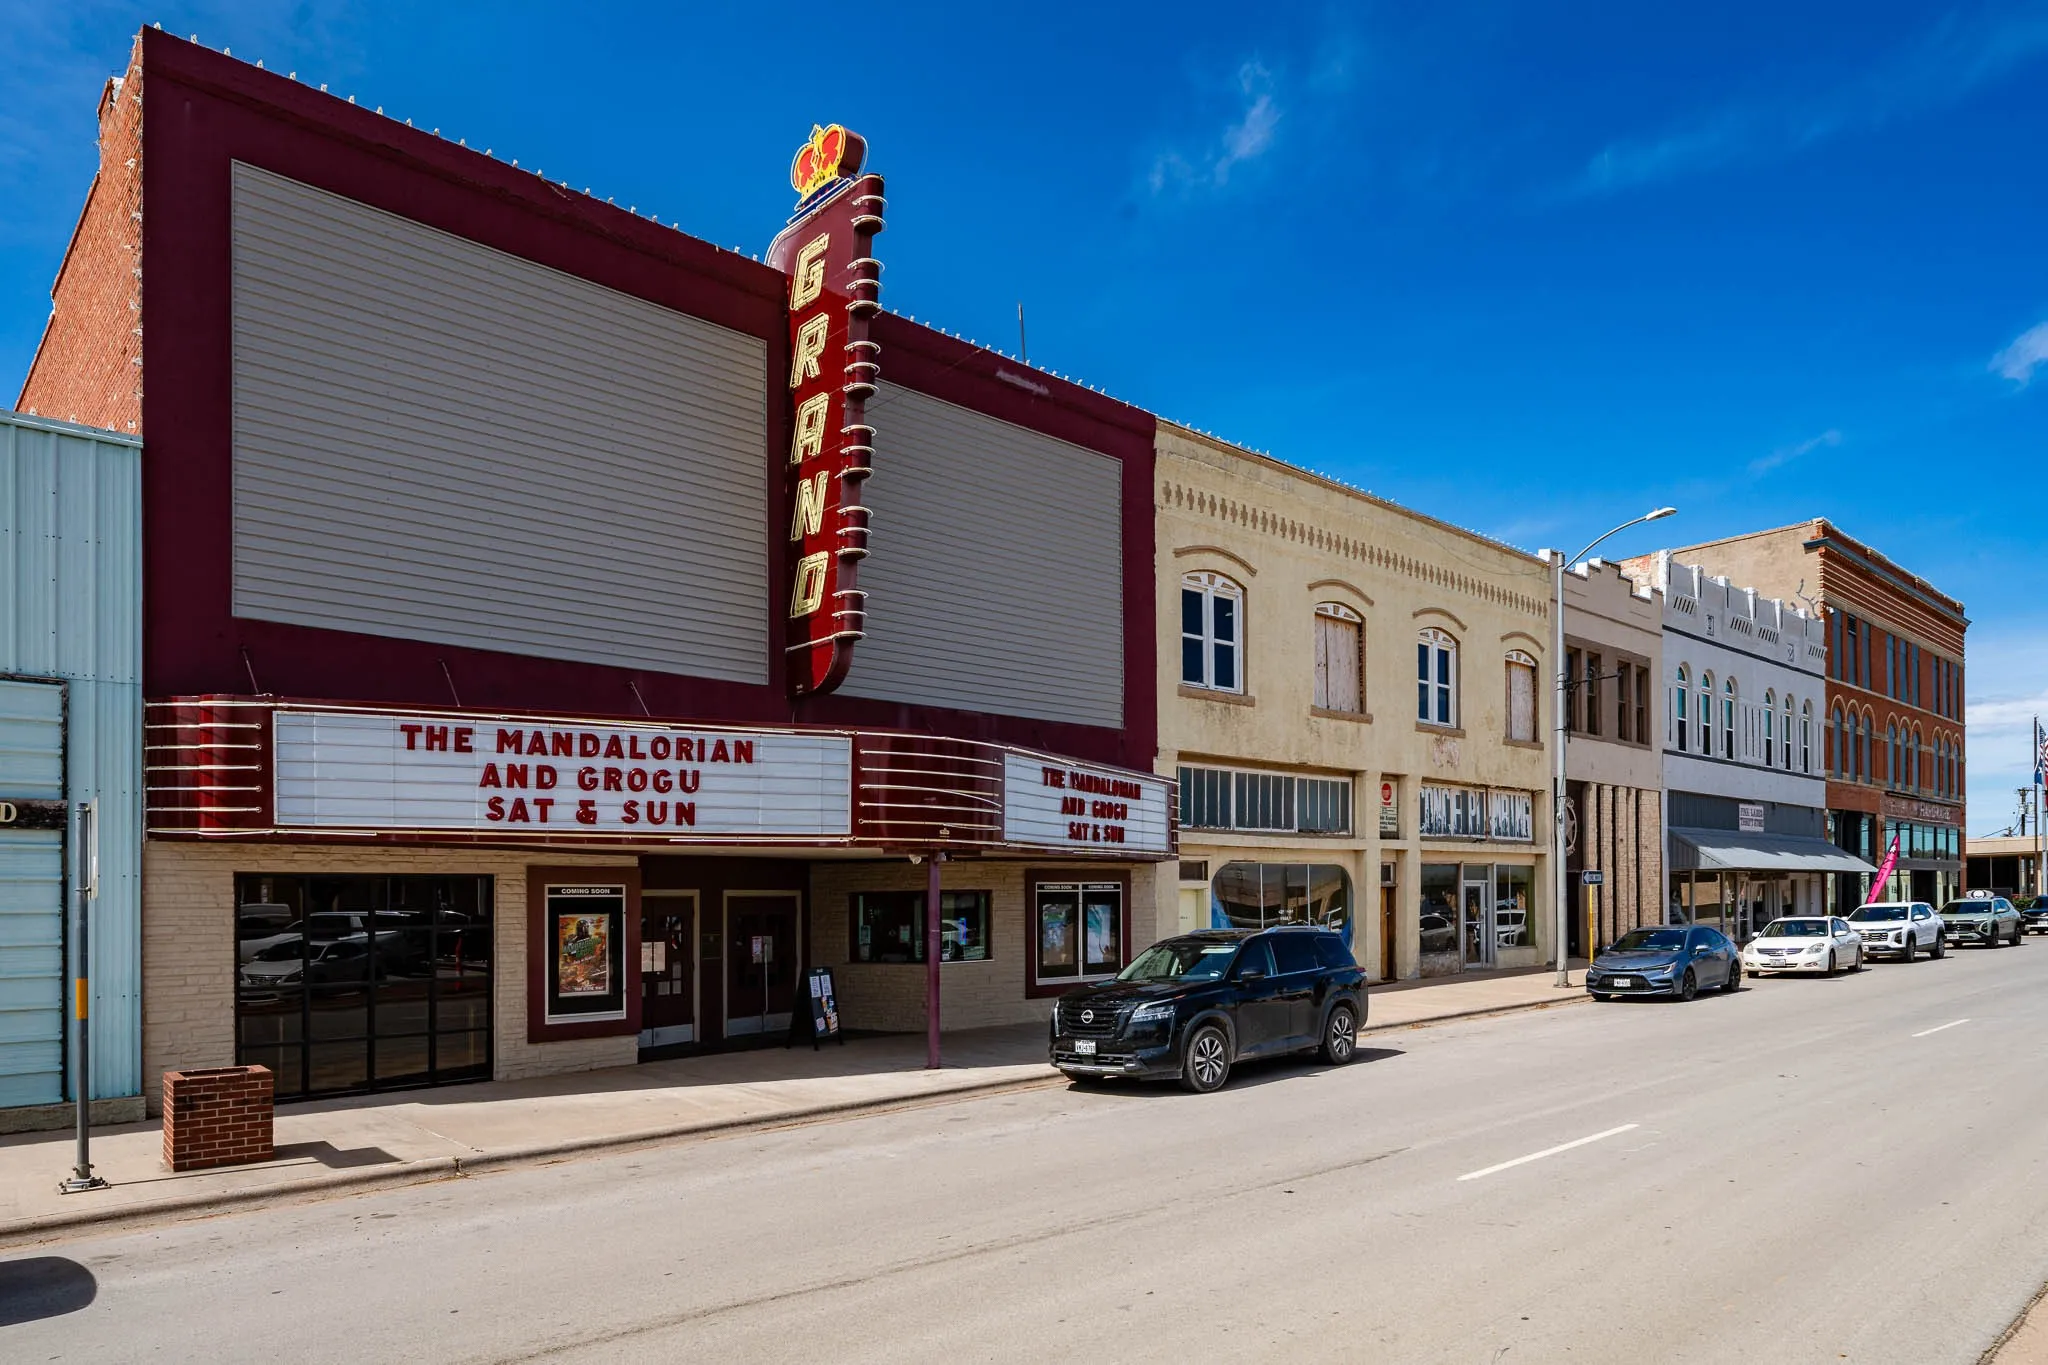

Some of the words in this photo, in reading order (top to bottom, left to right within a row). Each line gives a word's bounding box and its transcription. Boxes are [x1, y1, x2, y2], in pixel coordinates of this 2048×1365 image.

[789, 233, 830, 619] GRAND
[400, 724, 474, 753] THE
[496, 729, 754, 764] MANDALORIAN
[479, 763, 558, 789] AND
[577, 766, 700, 794] GROGU
[1042, 766, 1066, 789] THE
[1070, 771, 1141, 800] MANDALORIAN
[486, 796, 555, 823] SAT
[575, 799, 598, 825] &
[621, 800, 696, 827] SUN
[1061, 796, 1086, 816] AND
[1092, 800, 1128, 820] GROGU
[1068, 821, 1090, 841] SAT
[1092, 823, 1101, 842] &
[1103, 824, 1125, 843] SUN
[561, 887, 590, 895] COMING
